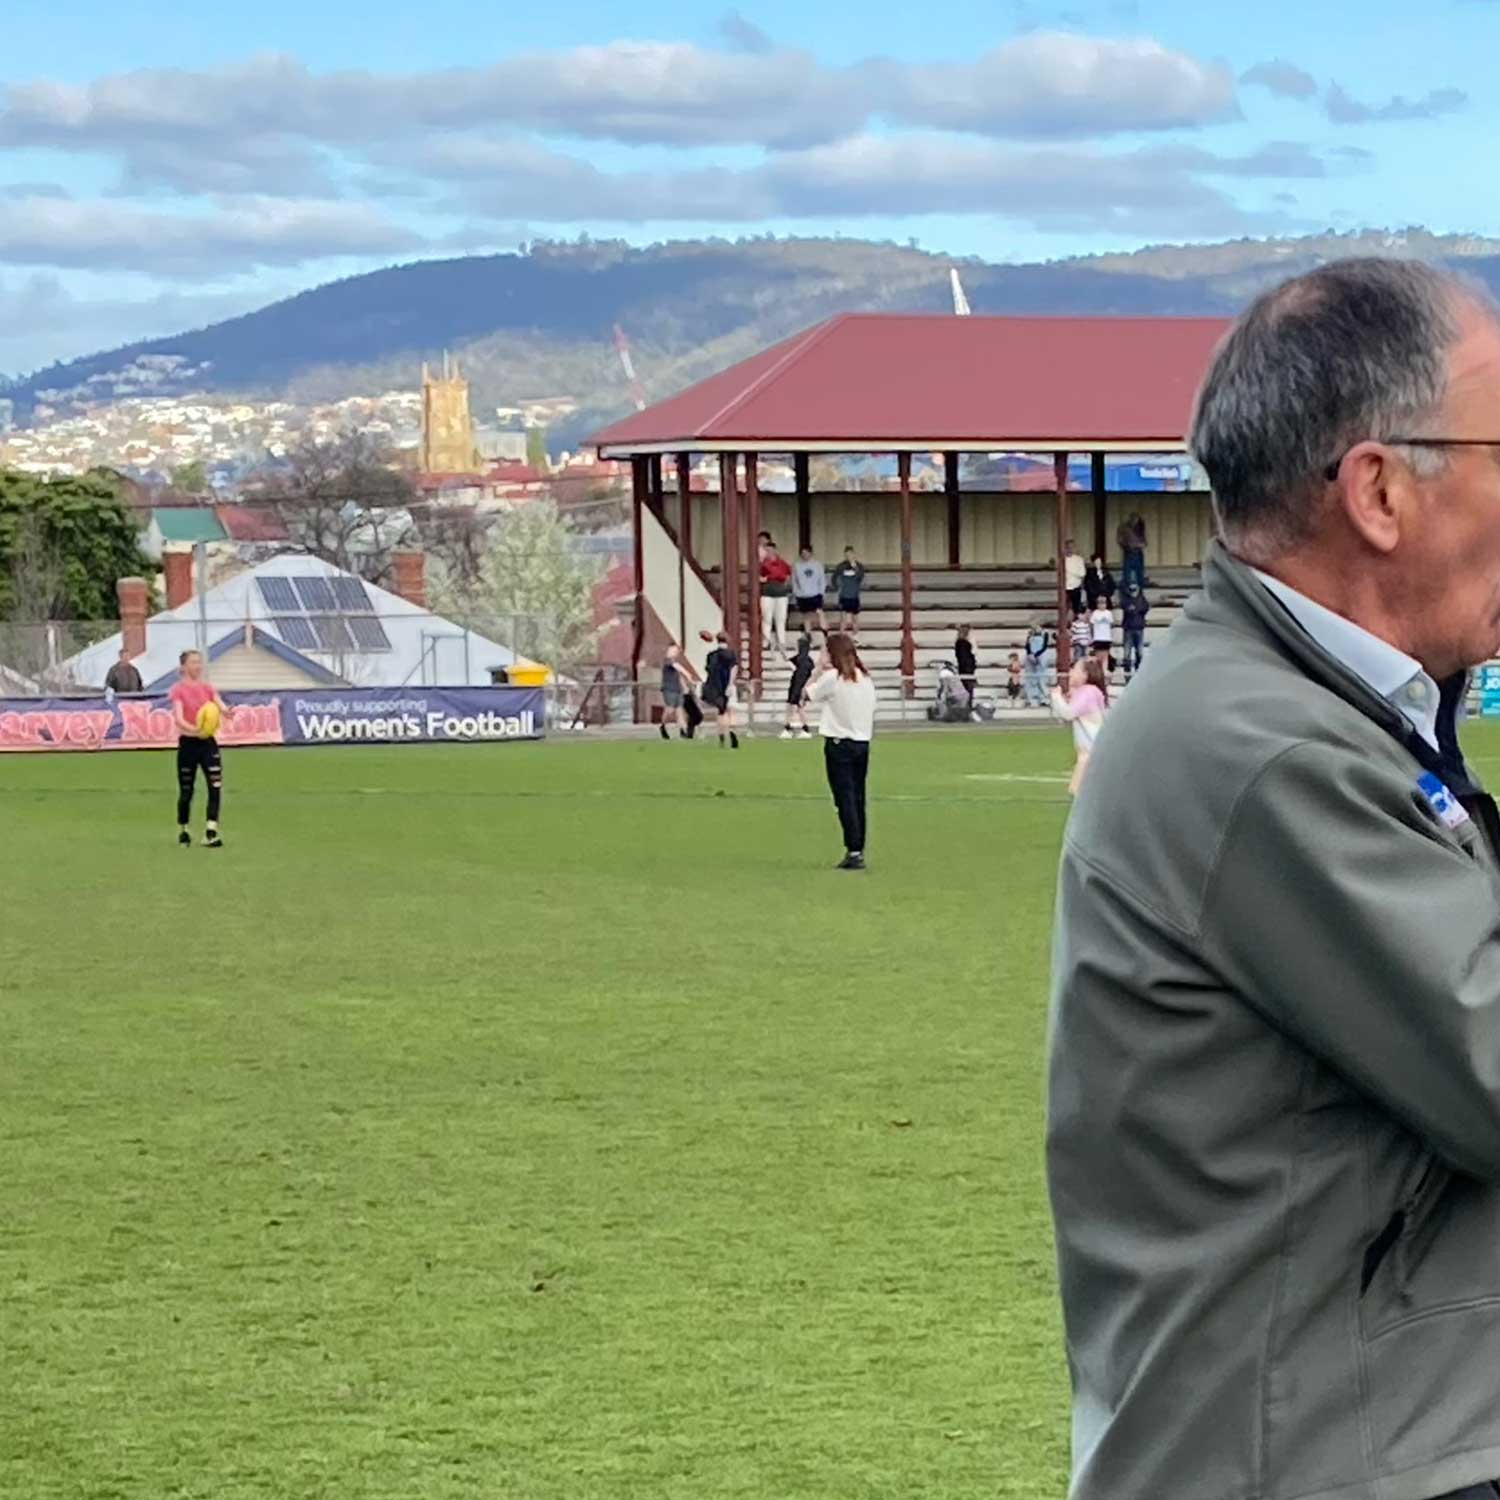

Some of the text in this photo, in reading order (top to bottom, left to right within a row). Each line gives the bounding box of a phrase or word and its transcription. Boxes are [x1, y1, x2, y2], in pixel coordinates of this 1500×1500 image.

[295, 699, 428, 714] Proudly supporting
[297, 710, 535, 739] Women's Football
